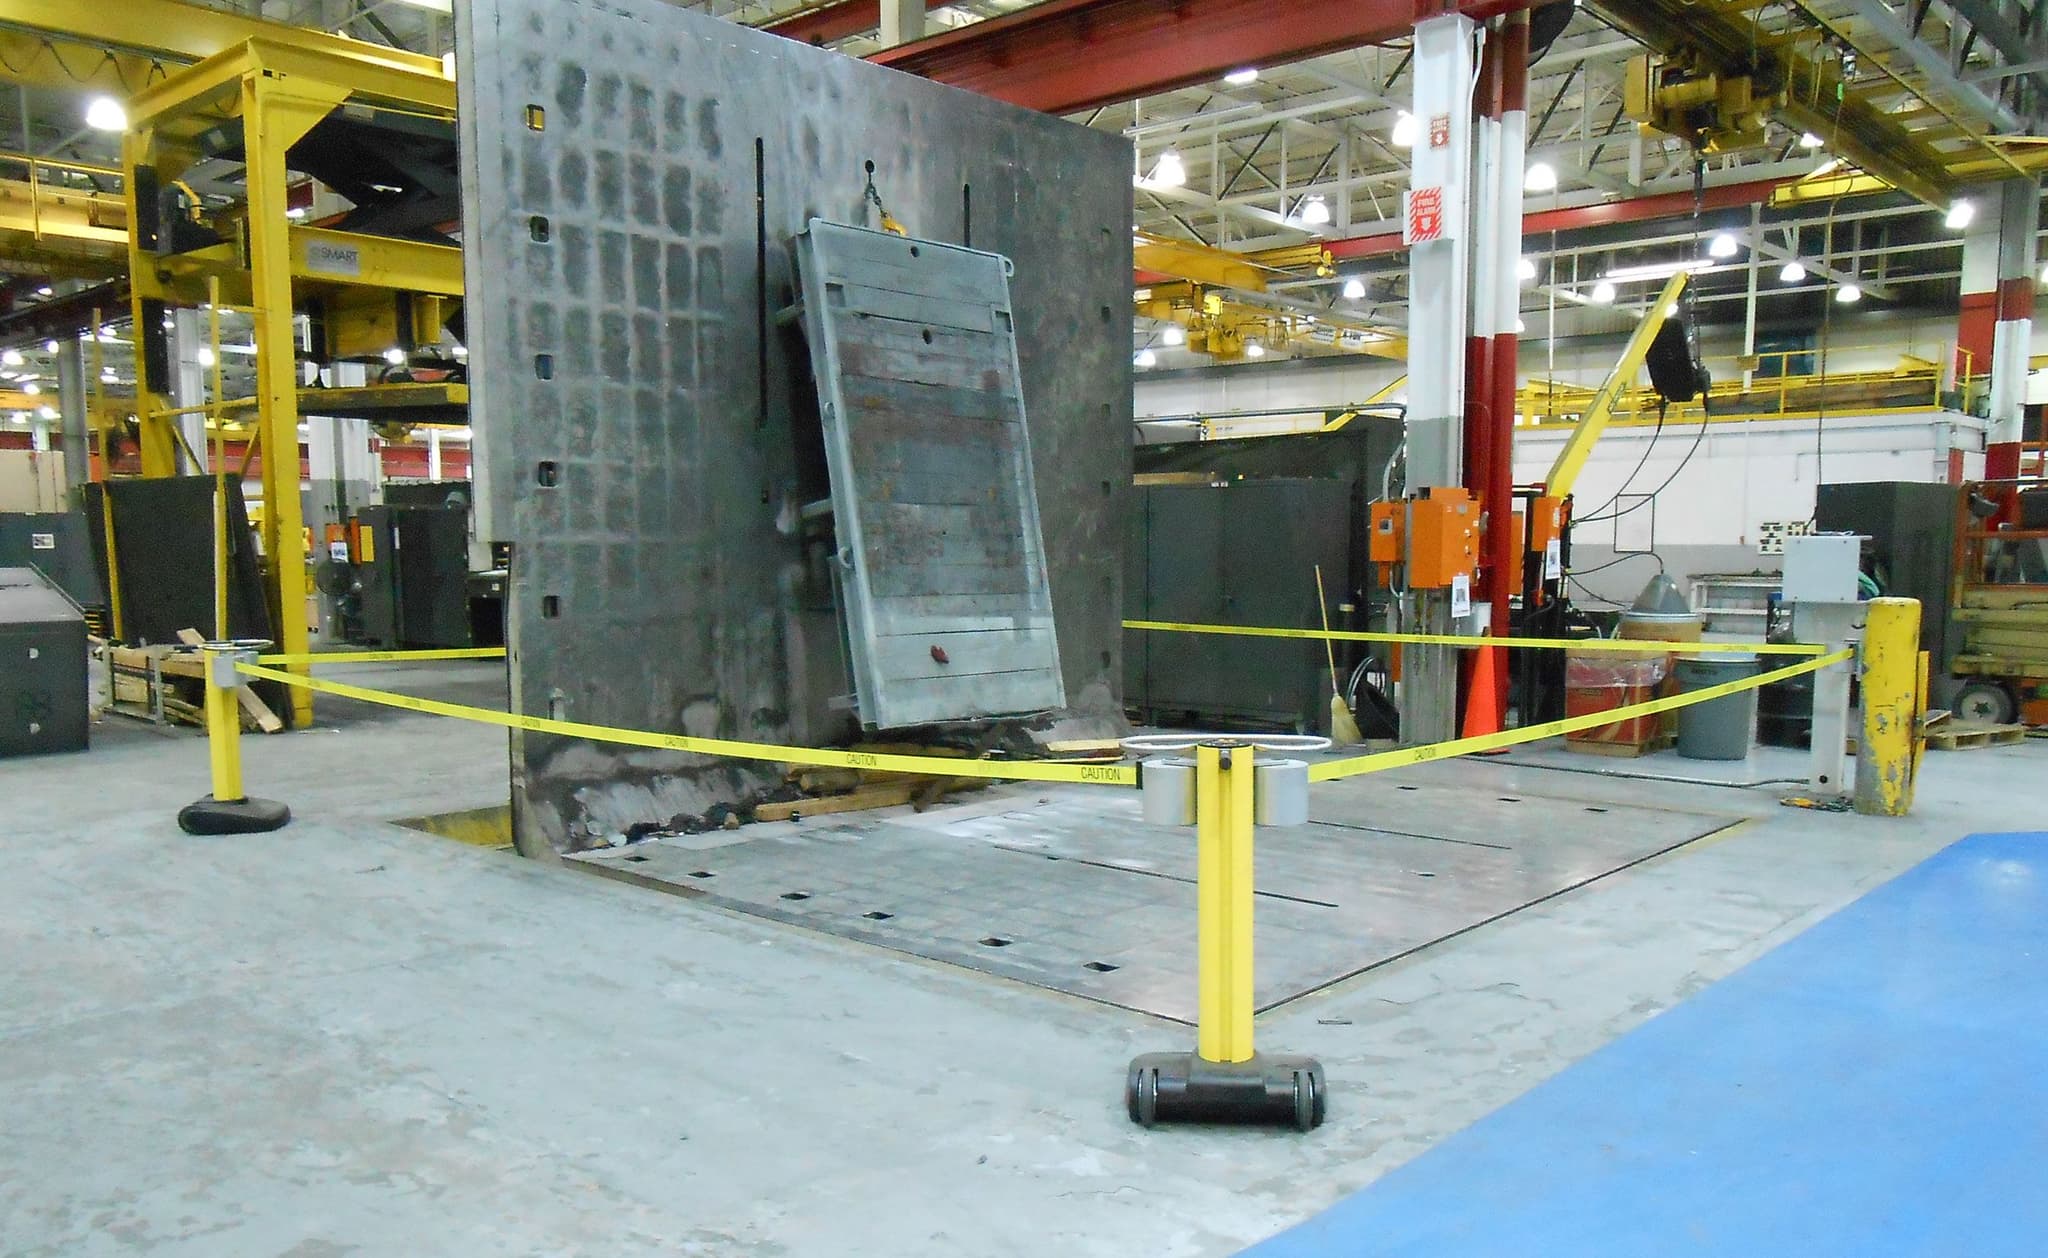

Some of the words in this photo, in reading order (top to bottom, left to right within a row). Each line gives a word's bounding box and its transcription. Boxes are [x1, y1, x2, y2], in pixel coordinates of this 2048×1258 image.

[321, 246, 358, 261] SMART
[847, 753, 876, 766] CAUTION
[1081, 766, 1120, 780] CAUTION
